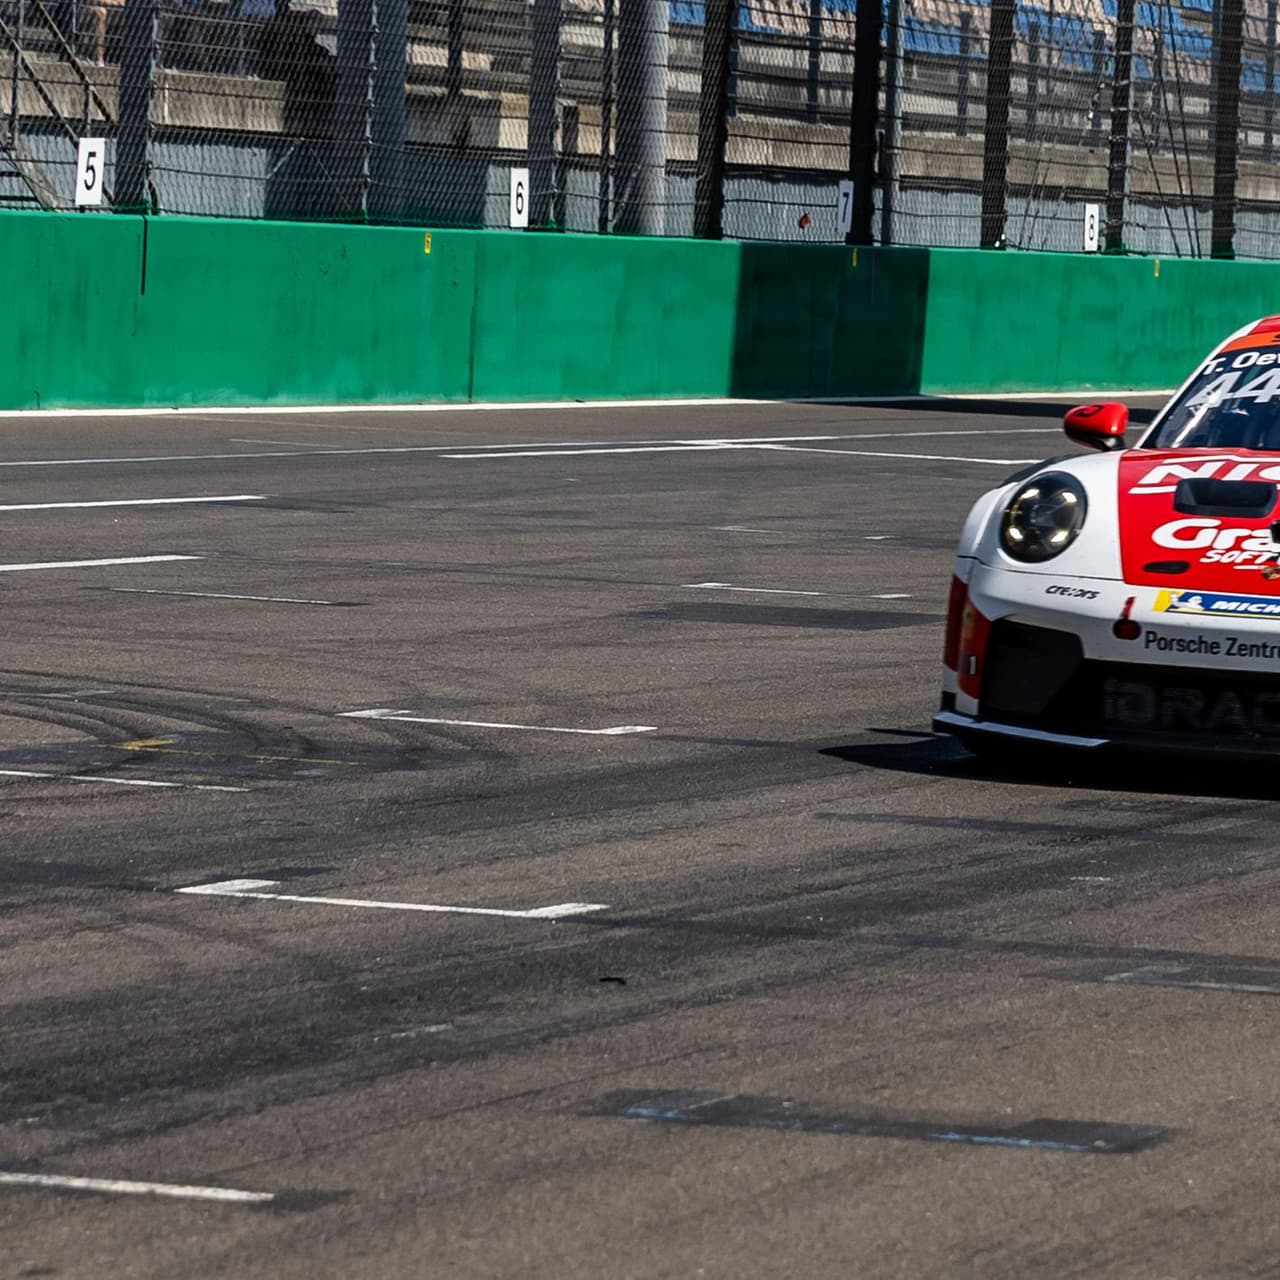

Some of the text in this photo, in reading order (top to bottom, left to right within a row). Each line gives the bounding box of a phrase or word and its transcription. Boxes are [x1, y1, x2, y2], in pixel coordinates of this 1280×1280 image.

[83, 151, 97, 191] 5
[516, 181, 524, 215] 6
[842, 192, 850, 224] 7
[1089, 213, 1095, 241] 8
[1200, 549, 1280, 564] SOFT
[1144, 631, 1221, 656] Porsche
